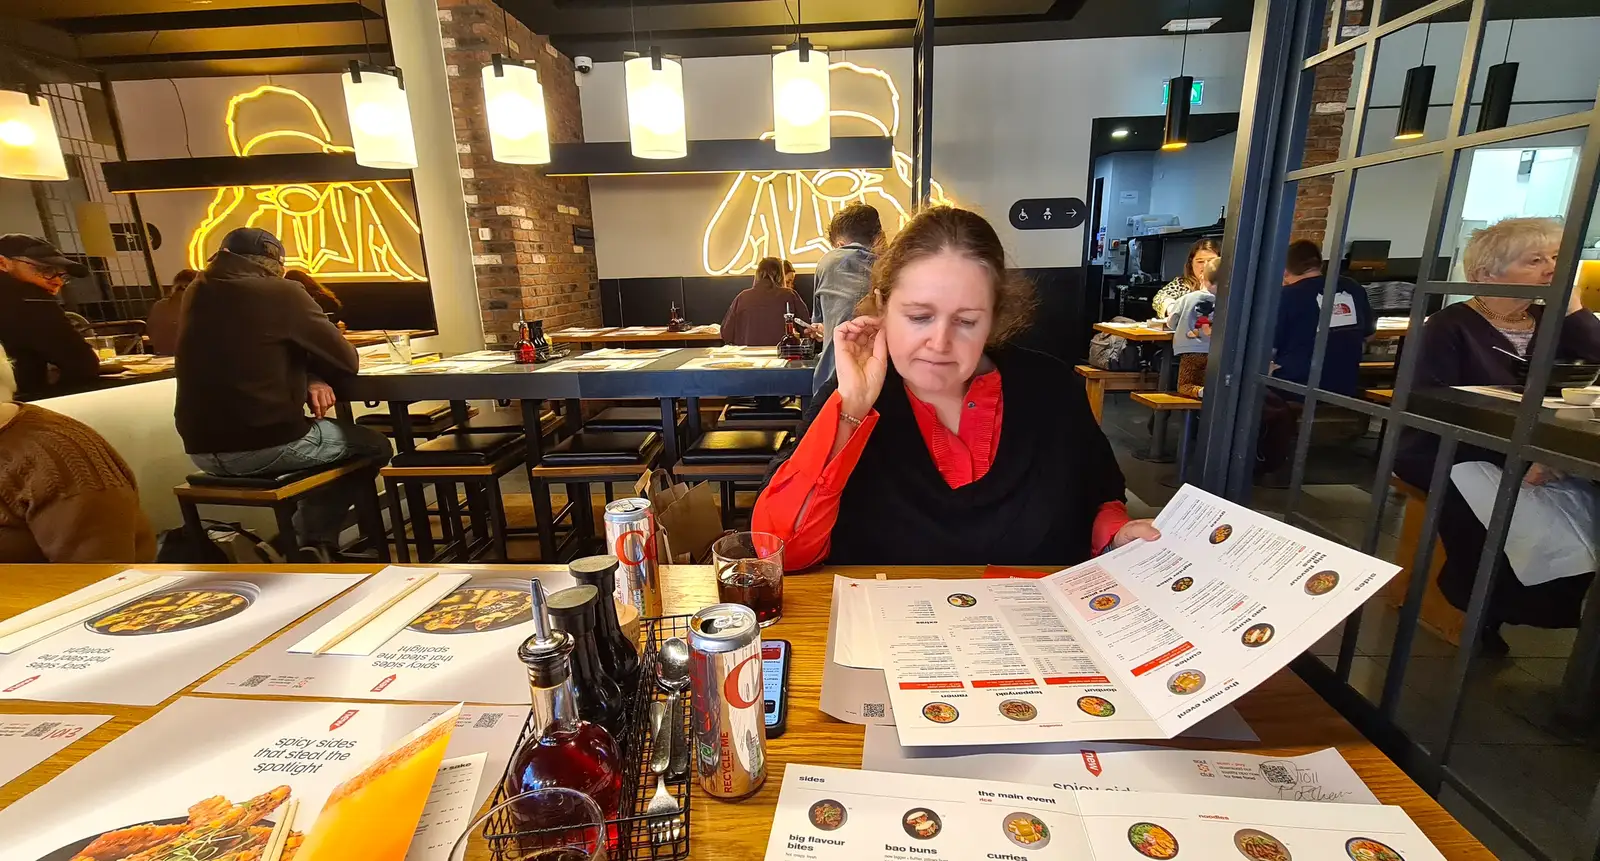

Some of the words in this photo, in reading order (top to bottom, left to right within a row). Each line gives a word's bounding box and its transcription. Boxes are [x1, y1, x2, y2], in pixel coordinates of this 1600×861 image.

[1302, 551, 1321, 567] bites
[1315, 553, 1327, 568] big
[1289, 563, 1316, 587] flavour
[1354, 572, 1376, 592] sides
[1248, 605, 1267, 617] bao
[1231, 616, 1251, 633] buns
[398, 645, 450, 654] spotlight
[377, 652, 396, 661] the
[397, 653, 428, 662] steal
[429, 654, 454, 663] that
[1174, 650, 1202, 668] curries
[371, 660, 406, 669] sides
[406, 661, 440, 670] spicy
[1225, 681, 1240, 691] the
[1201, 688, 1225, 704] main
[1177, 702, 1202, 719] event
[275, 736, 314, 751] spicy
[317, 737, 357, 750] sides
[721, 731, 730, 751] ME
[254, 748, 289, 760] that
[288, 749, 325, 760] steal
[325, 750, 351, 761] the
[254, 761, 324, 776] spotlight
[448, 762, 472, 770] sake
[1083, 752, 1099, 772] new
[723, 752, 733, 793] RECYCLE
[799, 776, 825, 784] sides
[978, 790, 995, 798] the
[998, 792, 1022, 801] main
[1026, 796, 1056, 804] event
[1198, 813, 1230, 821] noodles
[788, 833, 805, 844] big
[808, 836, 846, 847] flavour
[787, 842, 814, 852] bites
[884, 843, 907, 852] bao
[909, 845, 938, 855] buns
[986, 852, 1028, 861] curries
